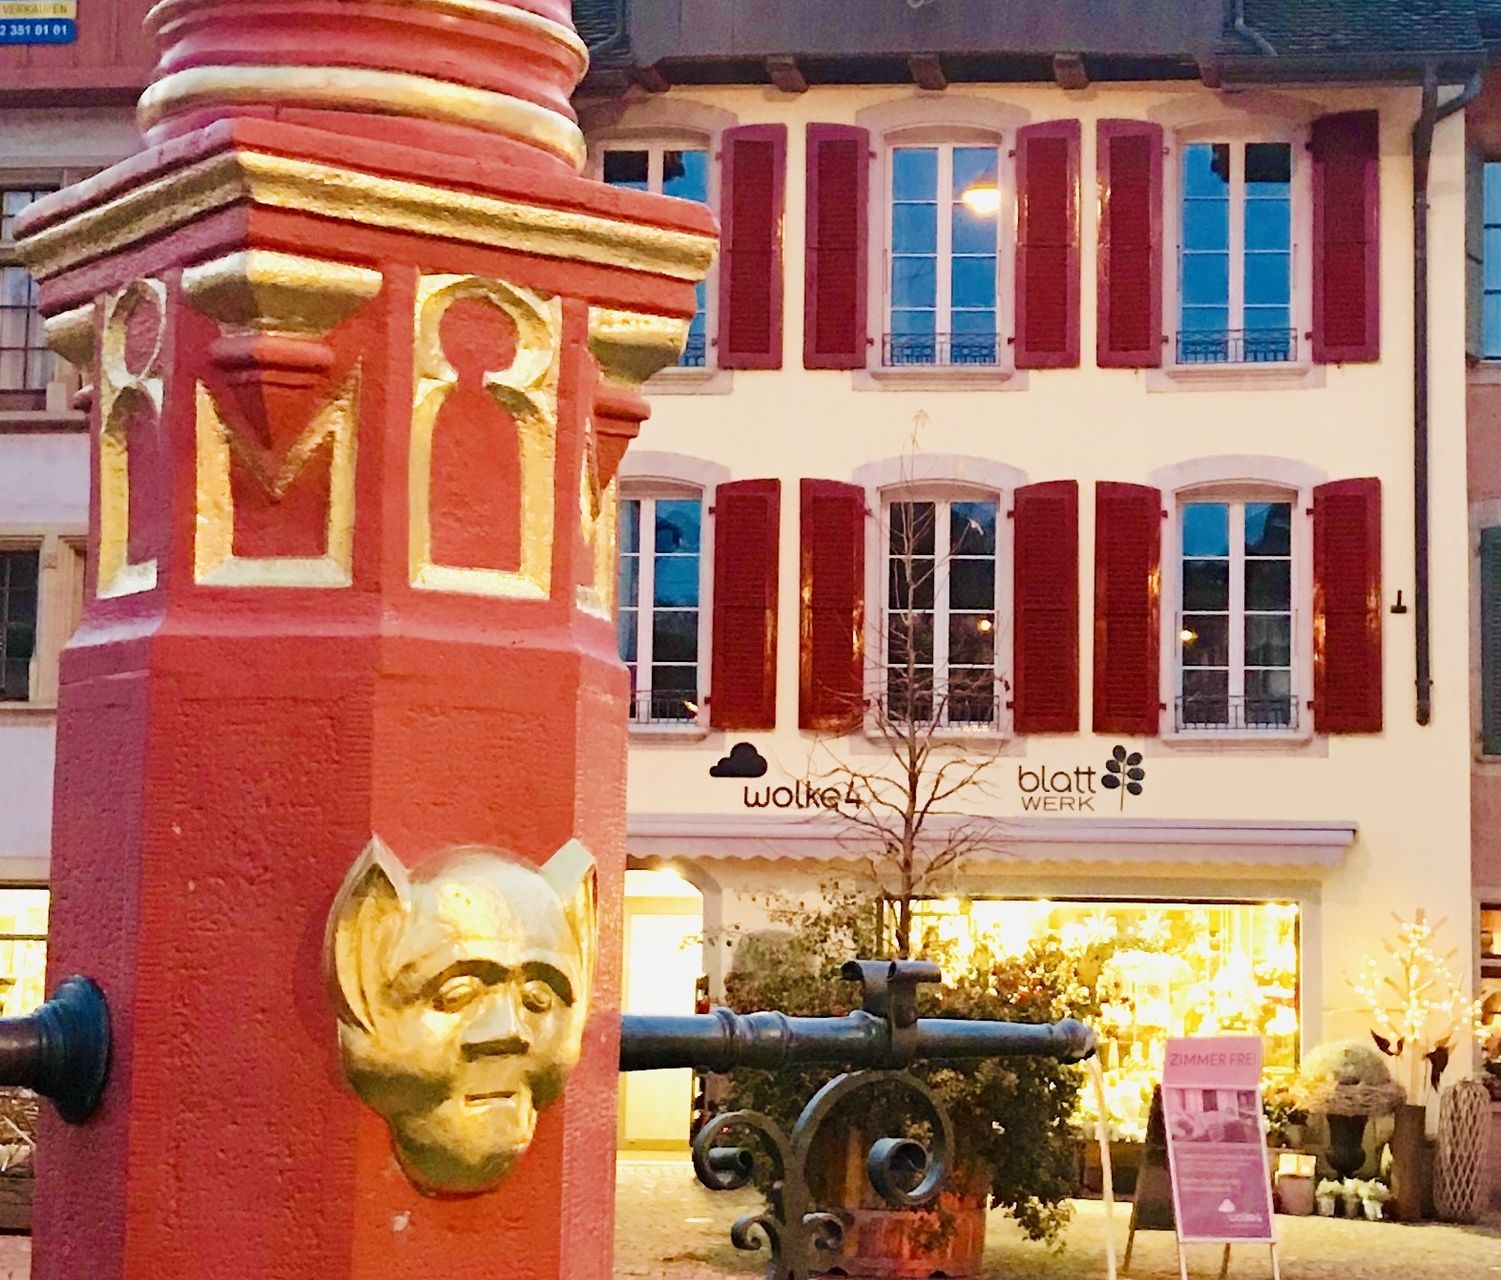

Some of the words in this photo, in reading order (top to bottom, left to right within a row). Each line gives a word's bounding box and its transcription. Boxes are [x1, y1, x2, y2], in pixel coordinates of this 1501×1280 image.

[3, 4, 67, 14] VERKAEN
[10, 24, 31, 36] 351
[53, 24, 67, 35] 01
[1018, 765, 1096, 793] blatt
[743, 779, 862, 809] wolke4
[1021, 796, 1095, 811] WERK
[1170, 1053, 1225, 1066] ZIMMER
[1229, 1053, 1257, 1065] FREI
